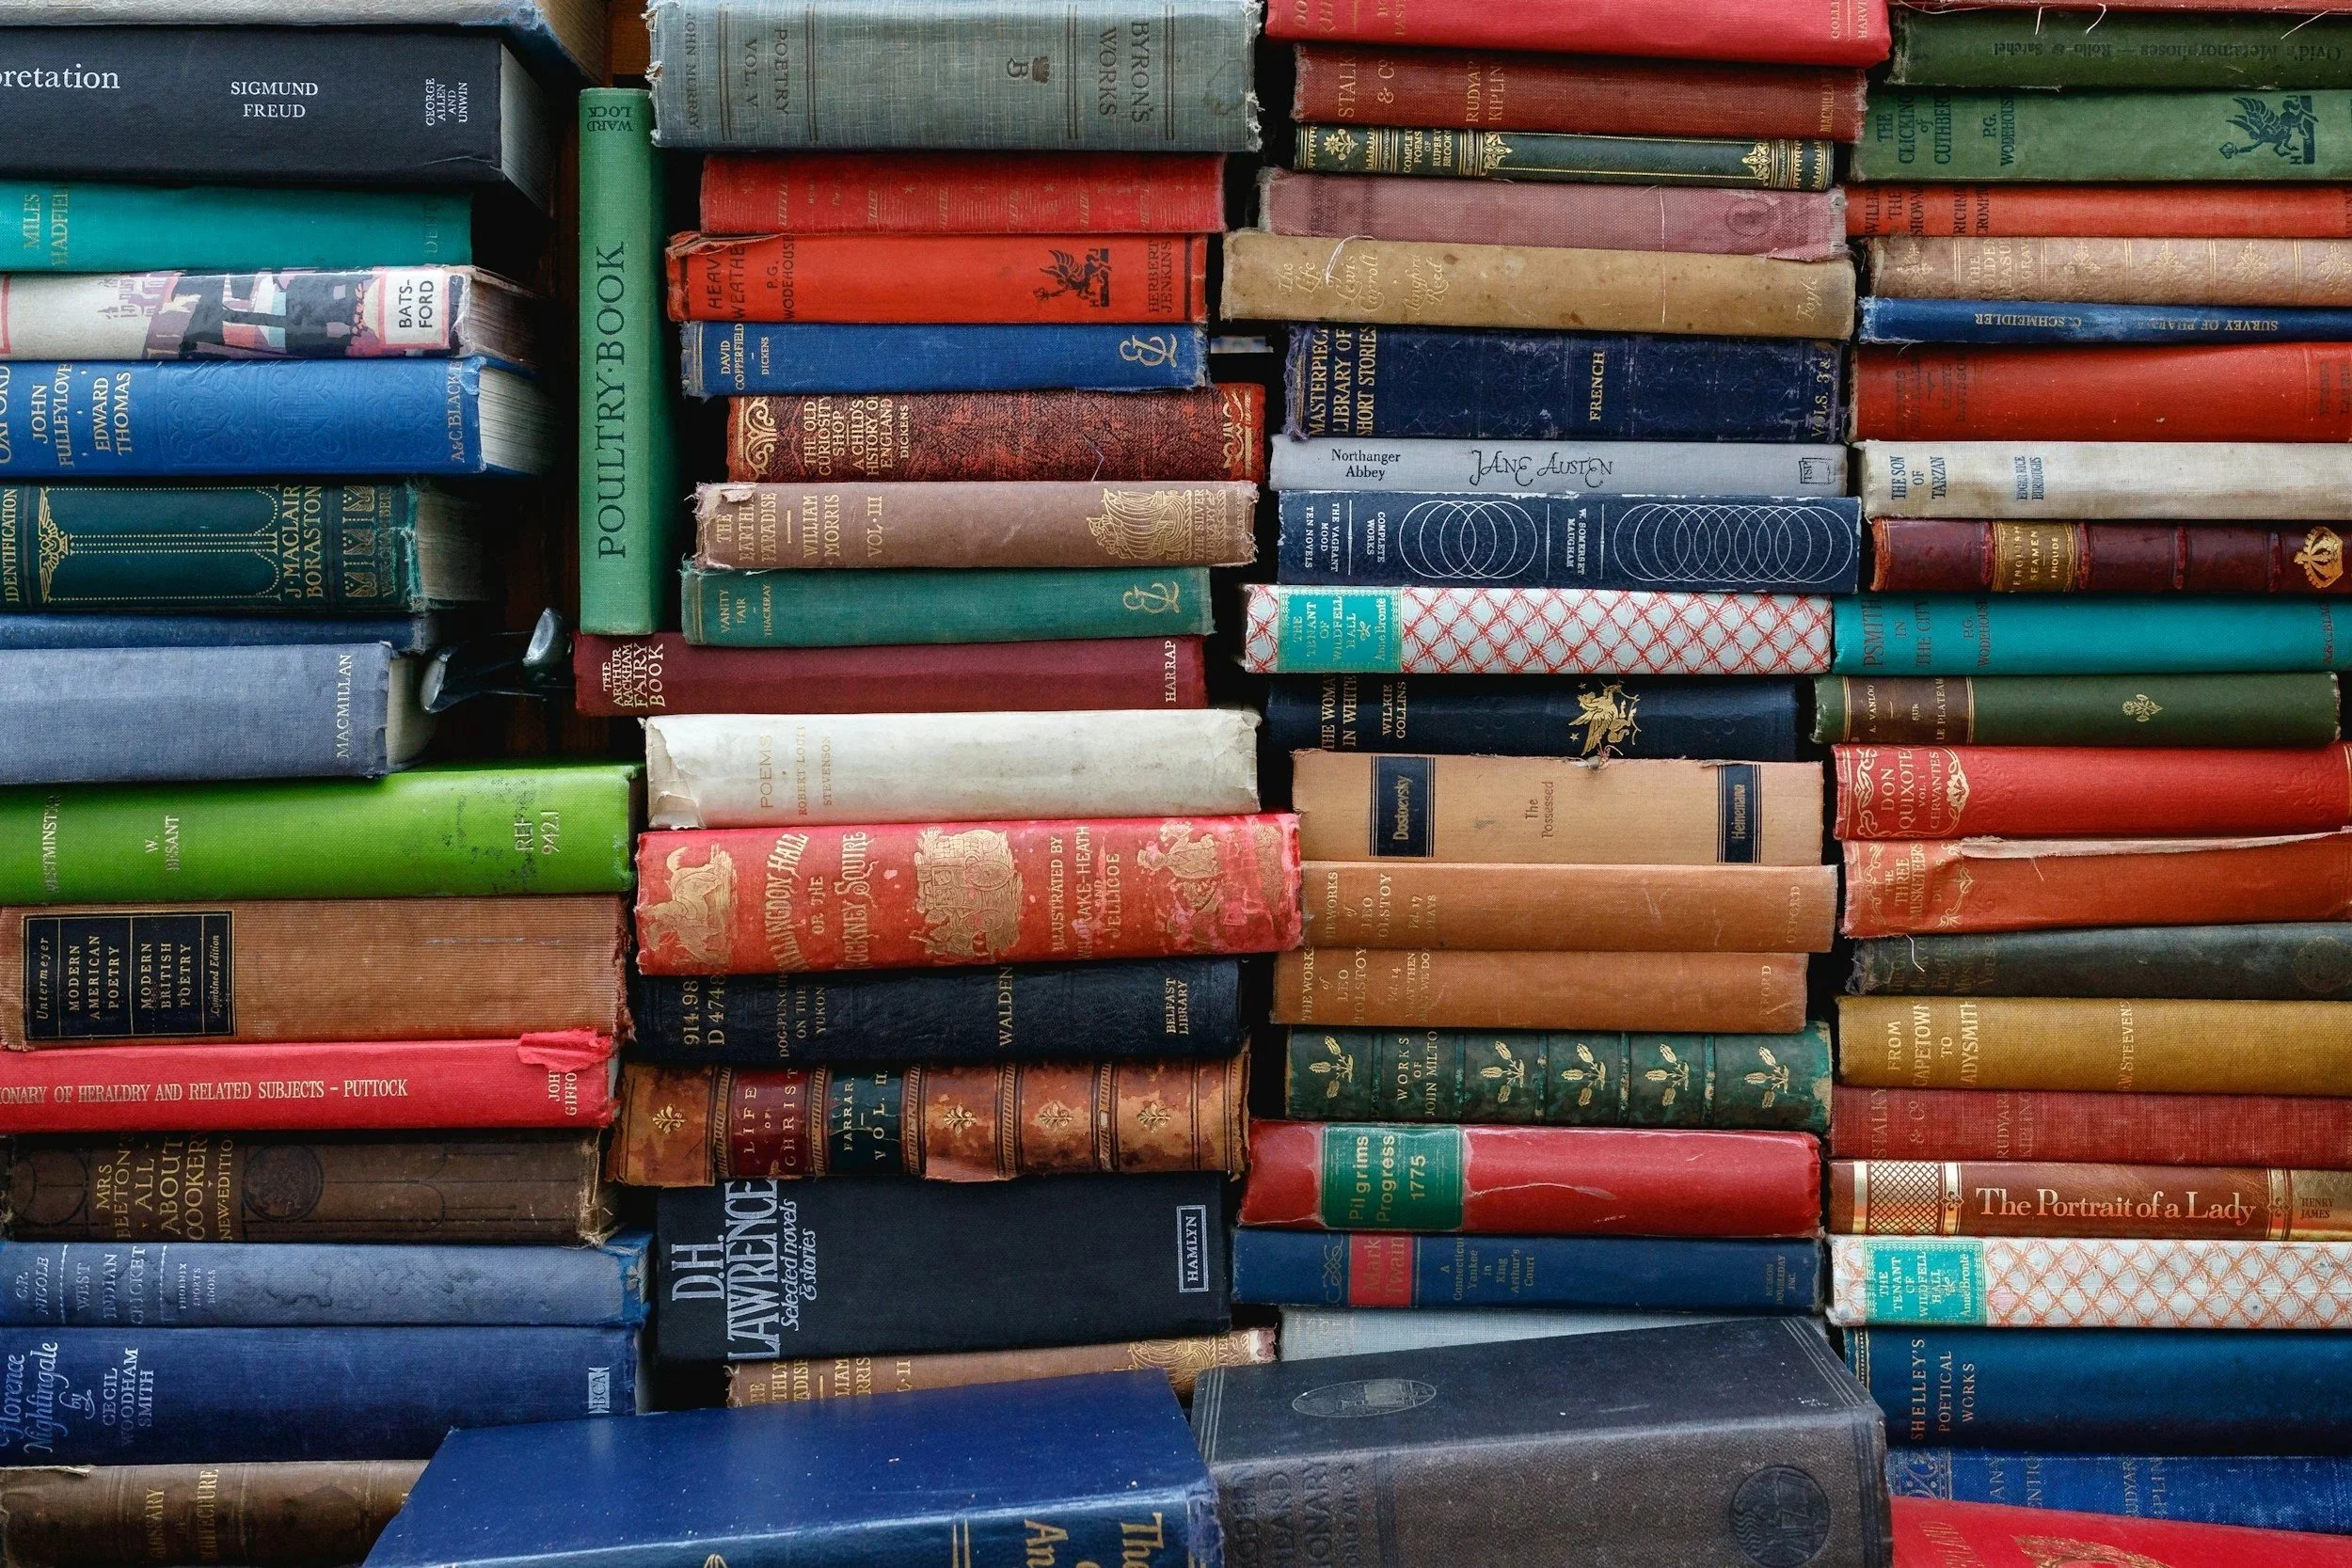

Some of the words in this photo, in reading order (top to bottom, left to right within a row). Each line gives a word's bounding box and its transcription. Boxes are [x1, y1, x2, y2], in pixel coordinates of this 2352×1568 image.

[230, 80, 319, 98] SIGMUND
[774, 26, 788, 118] POETRY
[1098, 25, 1118, 118] WORKS
[1131, 20, 1150, 124] BYRON'S
[243, 103, 307, 119] FREUD
[424, 77, 437, 127] GEORGE
[437, 83, 448, 121] ALLEN
[447, 87, 458, 117] AND
[457, 80, 469, 124] UNWIN
[586, 119, 635, 132] WARD
[587, 104, 631, 119] LOCK
[1412, 130, 1423, 164] POEMS
[24, 193, 41, 250] MILES
[766, 260, 780, 290] P.G.
[1147, 239, 1160, 314] HERBERT
[1159, 240, 1173, 314] JENKINS
[1339, 254, 1362, 306] Lewis
[1360, 253, 1385, 312] Carroll
[397, 278, 413, 329] BATS-
[418, 279, 435, 330] FORD
[1974, 312, 2064, 326] SCHMEIDLER
[720, 340, 731, 375] DAVID
[734, 323, 745, 391] COPPERFIELD
[760, 336, 771, 375] DICKENS
[1333, 328, 1353, 352] OF
[92, 375, 112, 451] EDWARD
[1332, 356, 1353, 432] LIBRARY
[1356, 390, 1375, 436] SHORT
[1589, 351, 1606, 421] FRENCH
[31, 383, 49, 444] JOHN
[113, 371, 134, 456] THOMAS
[803, 401, 818, 433] OLD
[832, 410, 845, 456] SHOP
[850, 399, 866, 456] CHILD'S
[880, 398, 894, 469] ENGLAND
[899, 404, 910, 459] DICKENS
[803, 435, 818, 467] THE
[852, 457, 865, 470] A
[1330, 447, 1402, 466] Northanger
[1344, 464, 1387, 479] Abbey
[1469, 449, 1534, 487] JANE
[1535, 451, 1614, 488] AUSTEN
[1889, 455, 1906, 477] SON
[1911, 469, 1925, 486] OF
[1930, 455, 1947, 500] TARZAN
[2013, 455, 2026, 474] RICE
[1890, 477, 1907, 500] THE
[2015, 472, 2028, 500] EDGAR
[2028, 457, 2044, 500] BURROUGHS
[303, 485, 325, 598] BORASTON
[715, 514, 732, 544] THE
[760, 492, 777, 562] PARADISE
[802, 494, 818, 559] WILLIAM
[823, 494, 840, 558] MORRIS
[1305, 505, 1314, 527] TEN
[1320, 521, 1329, 552] MOOD
[1366, 518, 1375, 555] WORKS
[1375, 510, 1386, 562] COMPLETE
[2, 488, 20, 603] IDENTIFICATION
[1305, 528, 1314, 569] NOVELS
[2028, 530, 2040, 581] SEAMEN
[719, 589, 731, 633] VANITY
[736, 596, 746, 625] FAIR
[762, 583, 772, 637] THACKERAY
[1861, 597, 1885, 669] PSMITH
[601, 661, 612, 691] THE
[611, 645, 623, 706] ARTHUR
[621, 642, 634, 708] RACKHAM
[633, 641, 649, 708] FAIRY
[647, 642, 665, 707] BOOK
[1165, 640, 1177, 704] HARRAP
[1342, 674, 1358, 722] WHITE
[335, 653, 354, 758] MACMILLAN
[1395, 680, 1407, 739] COLLINS
[1911, 703, 1920, 721] SUR
[1343, 729, 1358, 746] IN
[758, 734, 772, 809] POEMS
[796, 768, 808, 816] ROBERT
[821, 735, 833, 806] STEVENSON
[1880, 768, 1897, 813] DON
[1897, 749, 1916, 831] QUIXOTE
[1929, 751, 1943, 830] CERVANTES
[539, 809, 562, 855] 942.1
[1392, 774, 1415, 841] Dostoevsky
[1525, 798, 1540, 820] The
[1540, 781, 1555, 838] Possessed
[1730, 784, 1747, 840] Heinemann
[1048, 836, 1064, 855] BY
[806, 876, 825, 907] THE
[1048, 859, 1064, 953] ILLUSTRATED
[1895, 857, 1910, 906] THREE
[1908, 842, 1927, 919] MUSKETEERS
[812, 912, 825, 935] OR
[36, 935, 52, 1021] Untermeyer
[68, 943, 82, 1011] MODERN
[87, 935, 103, 1021] AMERICAN
[107, 945, 121, 1009] POETRY
[139, 942, 154, 1010] MODERN
[159, 942, 174, 1010] BRITISH
[179, 943, 193, 1008] POETRY
[997, 966, 1014, 1047] WALDEN
[1165, 977, 1177, 1035] BELFAST
[1177, 979, 1190, 1036] LIBRARY
[1395, 1036, 1410, 1101] WORKS
[1413, 1060, 1422, 1079] OF
[1886, 1020, 1902, 1071] FROM
[1940, 1035, 1954, 1059] TO
[54, 1085, 73, 1104] OF
[77, 1084, 151, 1103] HERALDRY
[154, 1083, 183, 1101] AND
[188, 1082, 252, 1101] RELATED
[257, 1080, 325, 1099] SUBJECTS
[342, 1078, 408, 1098] PUTTOCK
[743, 1085, 757, 1154] LIFE
[95, 1164, 113, 1211] MRS
[135, 1157, 154, 1212] ALL
[161, 1137, 183, 1235] ABOUT
[1348, 1135, 1372, 1221] Pilgrims
[1376, 1134, 1397, 1223] Progress
[1409, 1154, 1427, 1201] 1775
[2300, 1197, 2335, 1210] HENRY
[778, 1197, 799, 1256] novels
[1975, 1187, 2032, 1217] The
[2036, 1187, 2134, 1219] Portrait
[2136, 1190, 2162, 1219] of
[2163, 1203, 2181, 1219] a
[2185, 1191, 2257, 1227] Lady
[2300, 1207, 2331, 1220] JAMES
[670, 1233, 725, 1303] D.H.
[723, 1178, 781, 1361] LAWRENCE
[1184, 1215, 1199, 1283] HAMLYN
[1363, 1238, 1381, 1292] Mark
[1386, 1236, 1406, 1297] Twain
[1467, 1249, 1479, 1290] Yankee
[34, 1256, 51, 1316] NICOLE
[75, 1261, 91, 1312] WEST
[779, 1255, 801, 1332] Selected
[1878, 1271, 1890, 1298] THE
[1890, 1256, 1904, 1313] TENANT
[1904, 1275, 1915, 1295] OF
[24, 1340, 73, 1454] Nightingale
[59, 1388, 96, 1419] by
[101, 1368, 119, 1428] CECIL
[137, 1370, 155, 1429] SMITH
[590, 1372, 608, 1407] BCA
[1910, 1338, 1928, 1441] SHELLEY'S
[1938, 1350, 1953, 1433] POETICAL
[1962, 1362, 1976, 1422] WORKS
